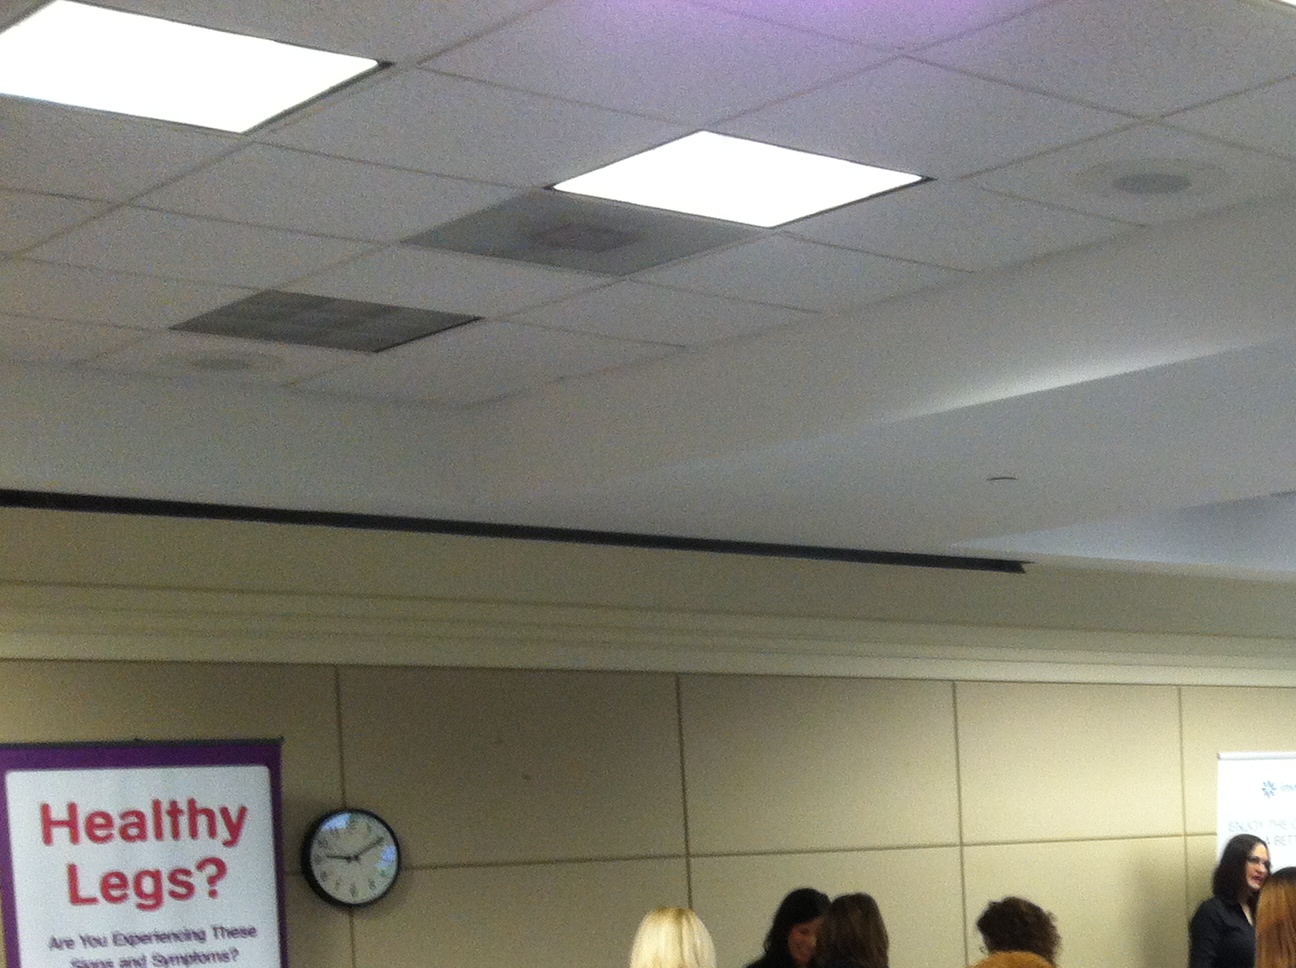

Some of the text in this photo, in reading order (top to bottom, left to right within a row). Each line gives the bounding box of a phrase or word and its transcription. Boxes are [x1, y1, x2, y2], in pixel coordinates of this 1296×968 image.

[40, 797, 248, 848] Healthy
[66, 856, 228, 911] Legs?
[49, 924, 258, 951] Are You Experiencing These
[150, 946, 240, 968] Symptoms?
